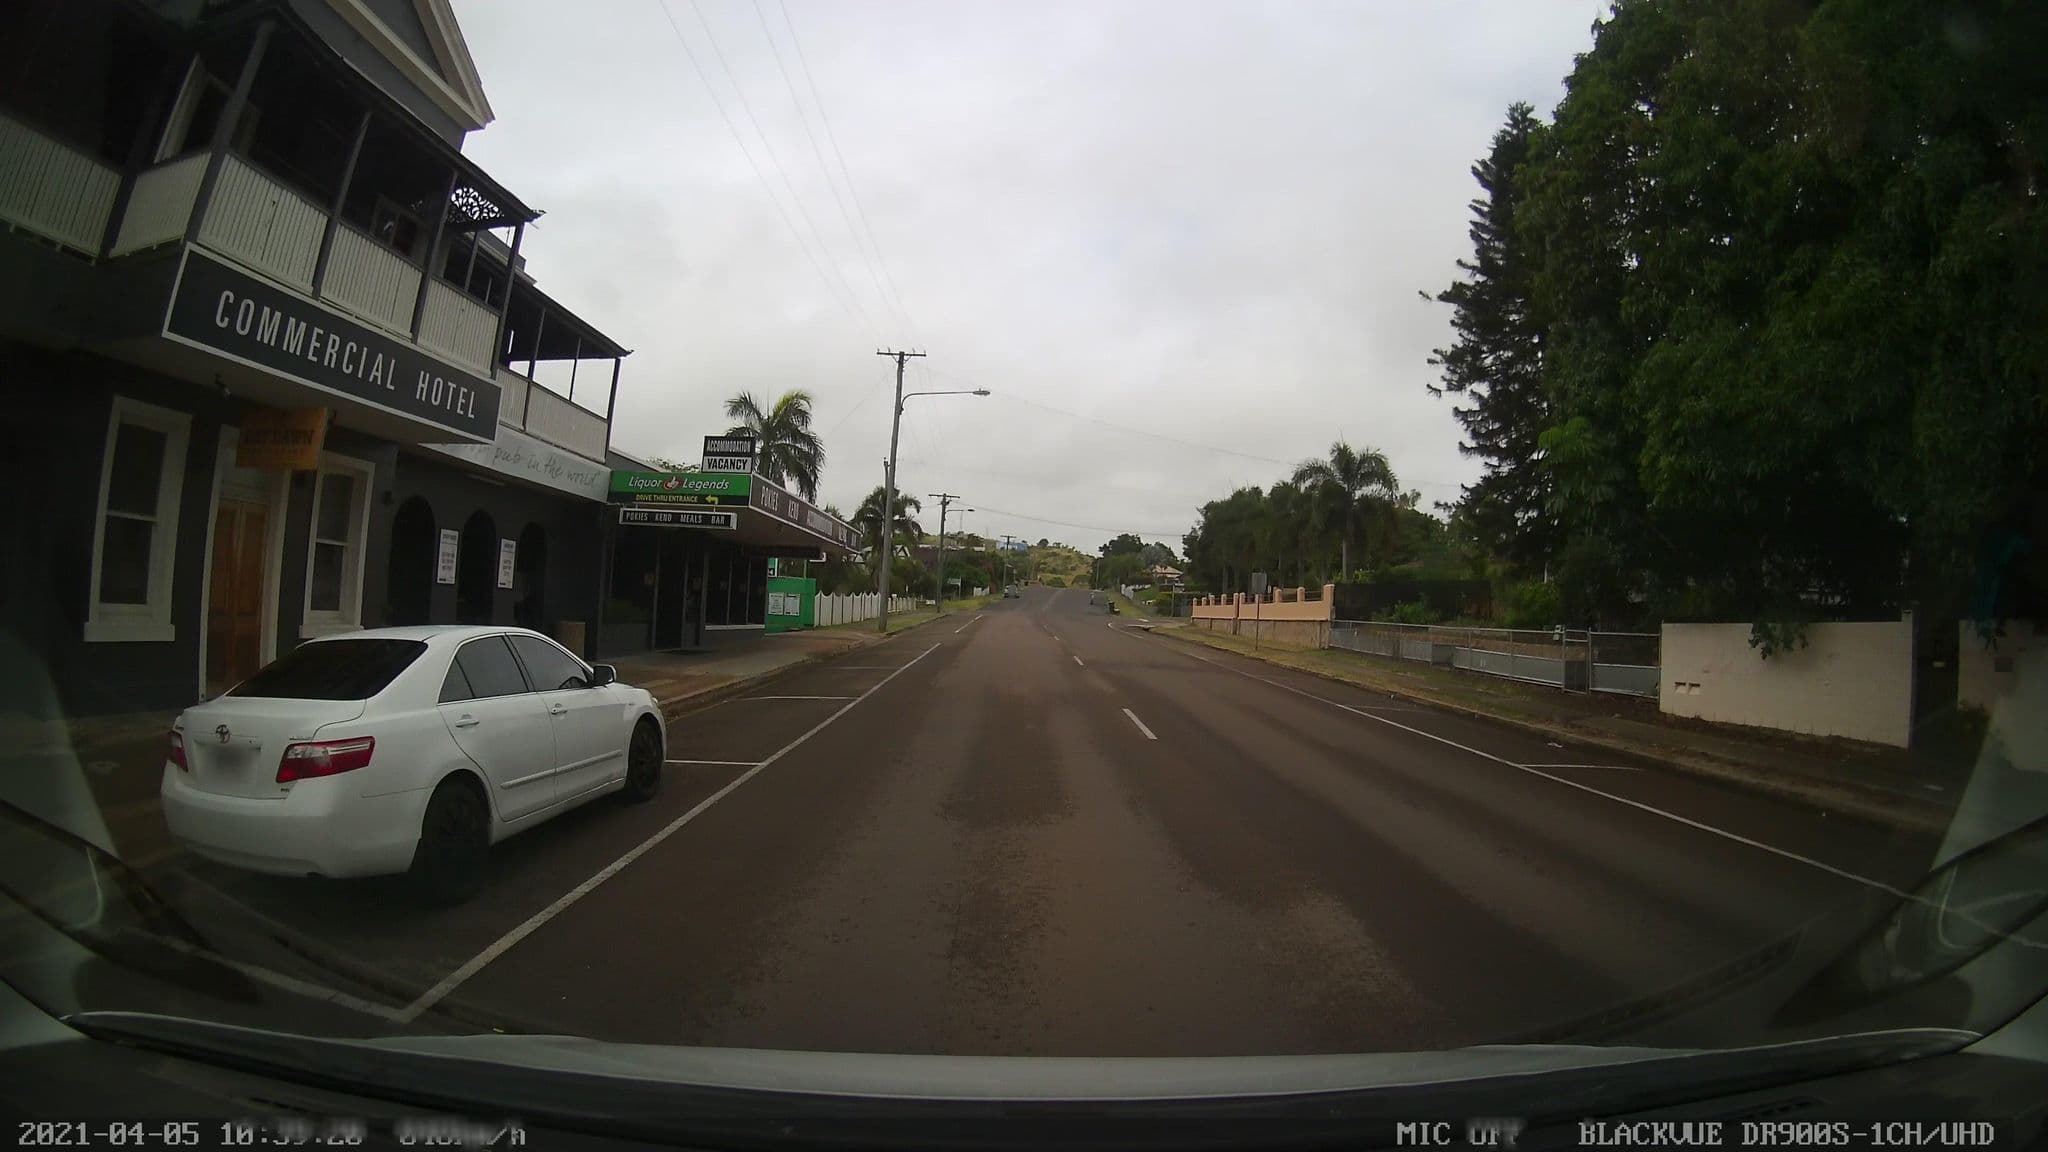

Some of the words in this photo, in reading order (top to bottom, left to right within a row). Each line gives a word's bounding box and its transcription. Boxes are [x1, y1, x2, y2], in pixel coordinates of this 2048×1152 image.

[214, 289, 397, 391] COMMERCIAL
[415, 371, 477, 420] HOTEL
[706, 439, 751, 452] ACCOMMODATION
[492, 447, 521, 465] pub
[707, 457, 748, 470] VACANCY
[628, 475, 662, 490] Liquor
[682, 478, 729, 490] Legends
[636, 494, 652, 502] DRIVE
[668, 495, 698, 503] ENTRANCE
[626, 512, 648, 522] POKIES
[655, 513, 672, 523] KENO
[680, 514, 702, 524] MEALS
[711, 515, 725, 525] BAR
